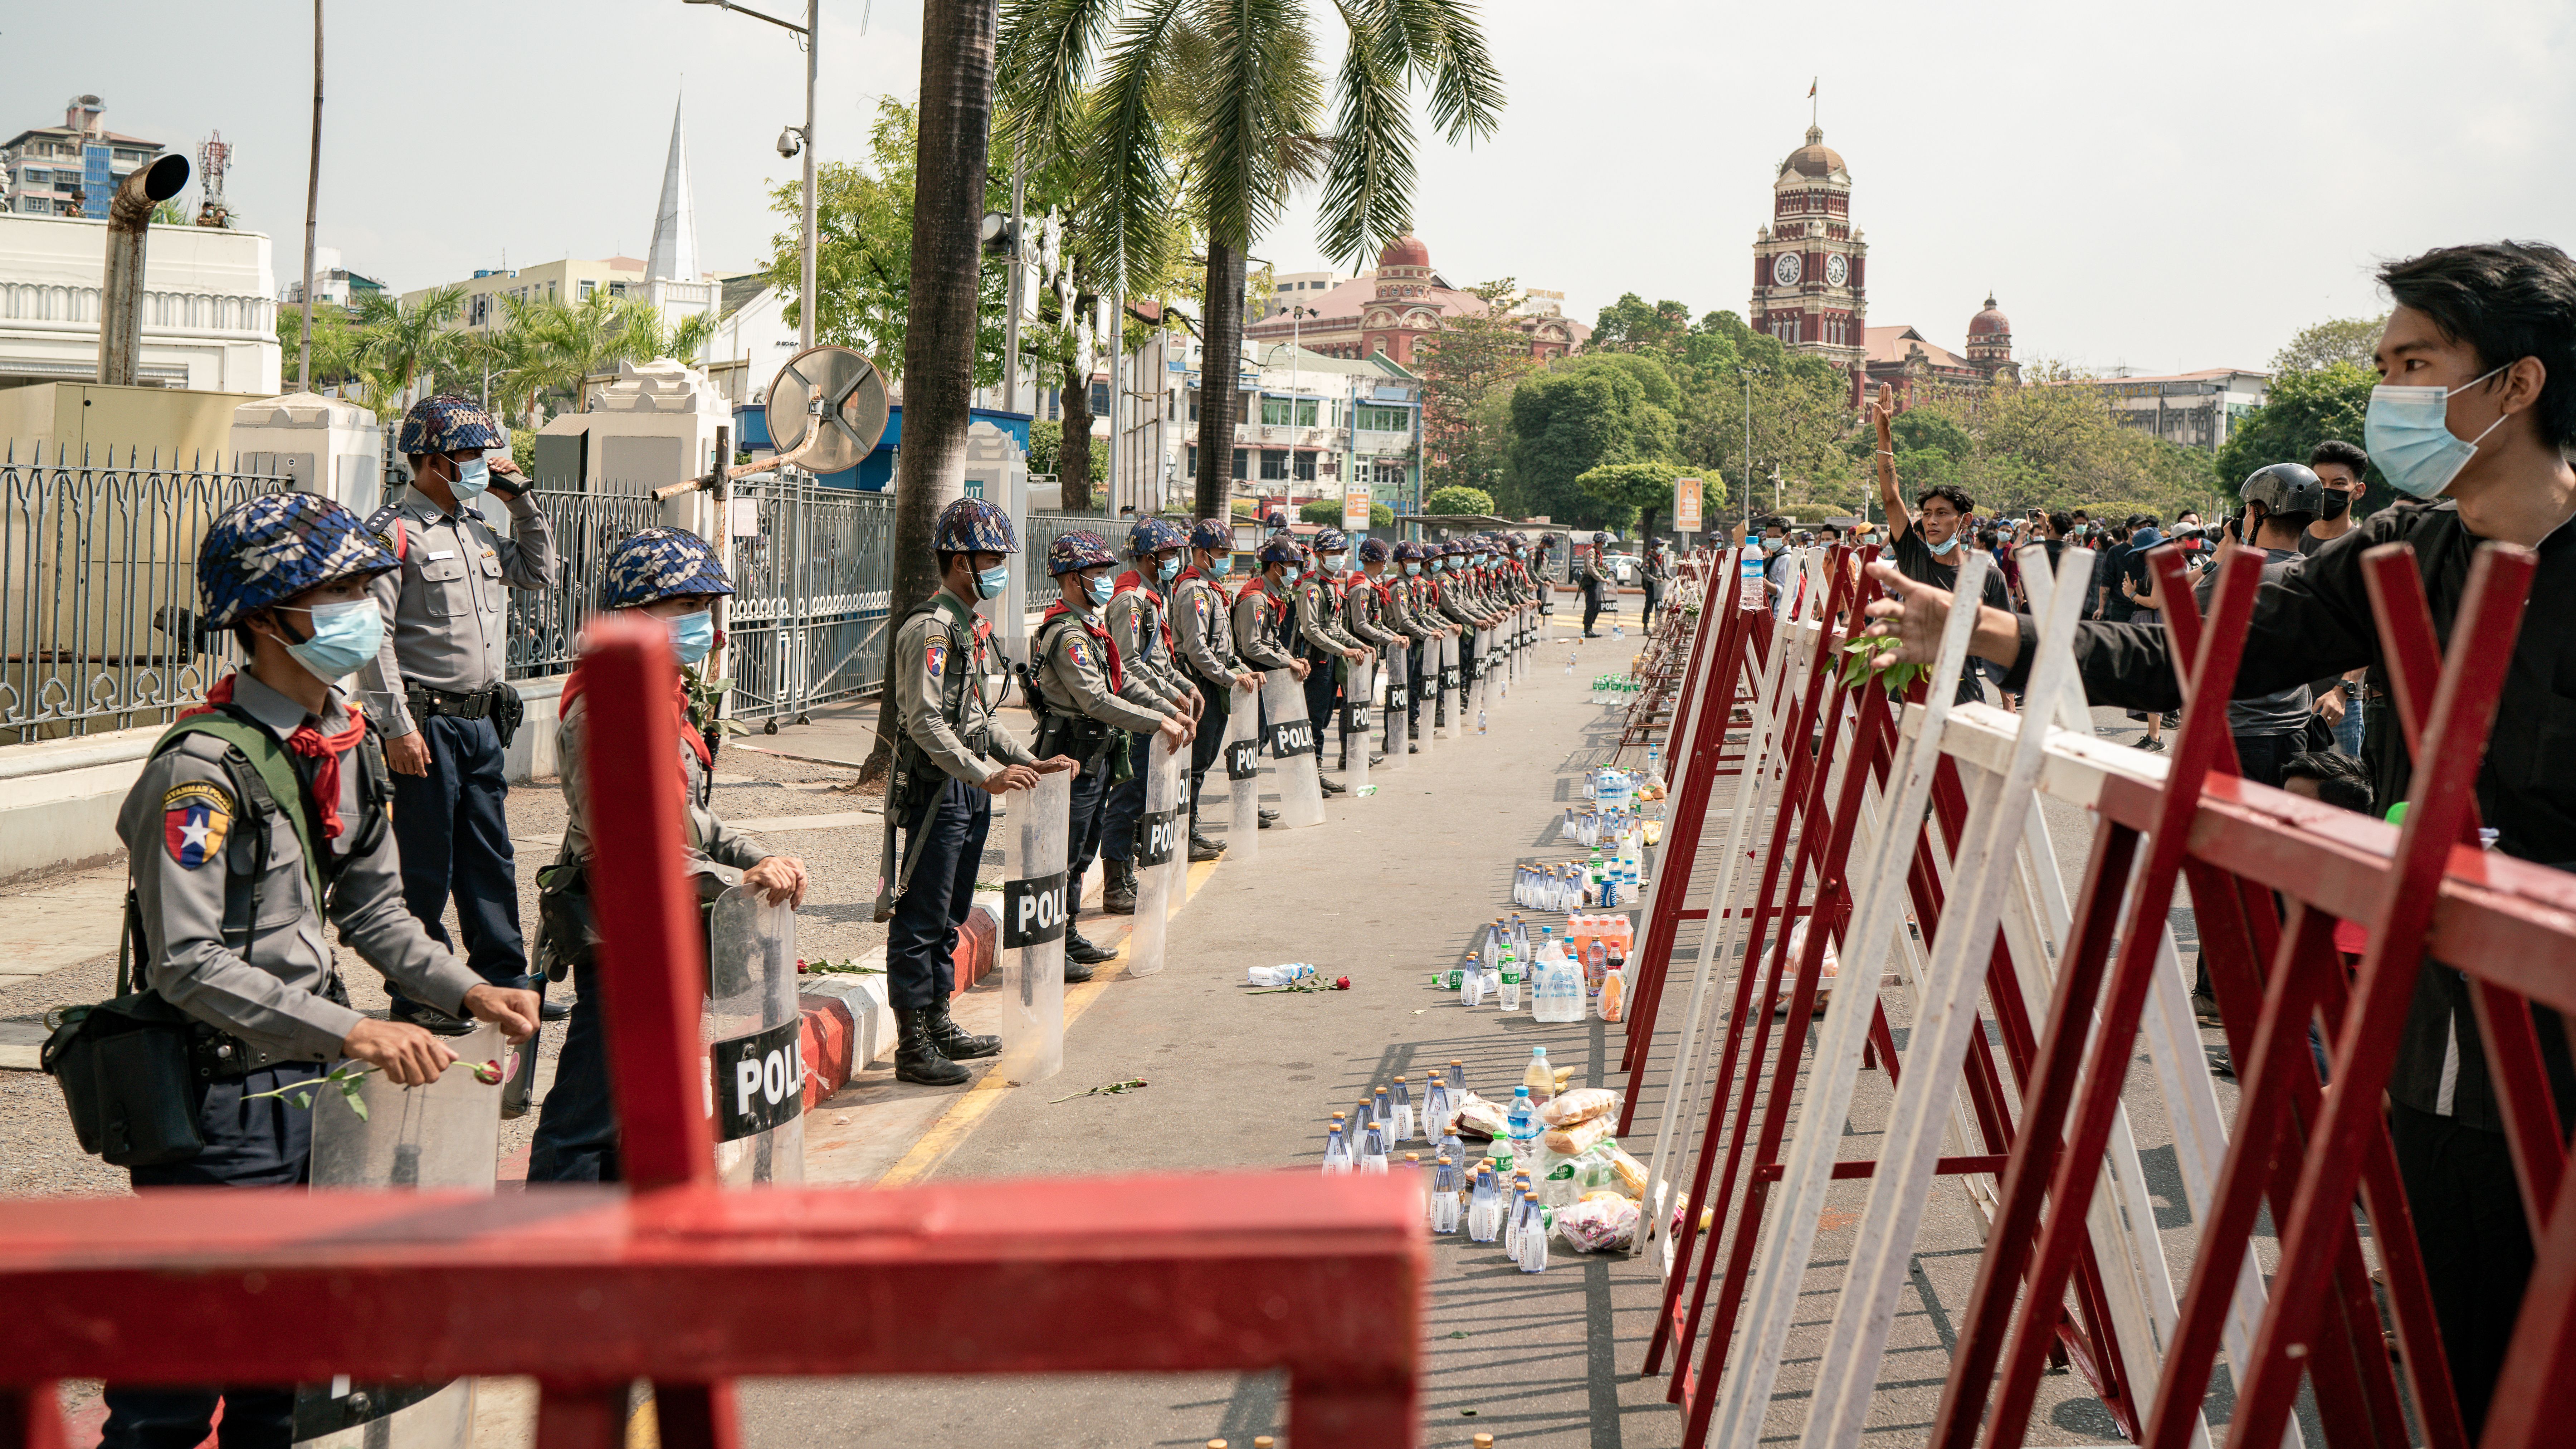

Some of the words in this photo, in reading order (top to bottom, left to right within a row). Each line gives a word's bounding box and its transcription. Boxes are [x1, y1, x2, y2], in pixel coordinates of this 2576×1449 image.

[1064, 638, 1076, 647] MYANMAR
[165, 785, 209, 800] MYANMAR
[1019, 886, 1066, 932] POLI
[737, 1038, 801, 1116] POLI
